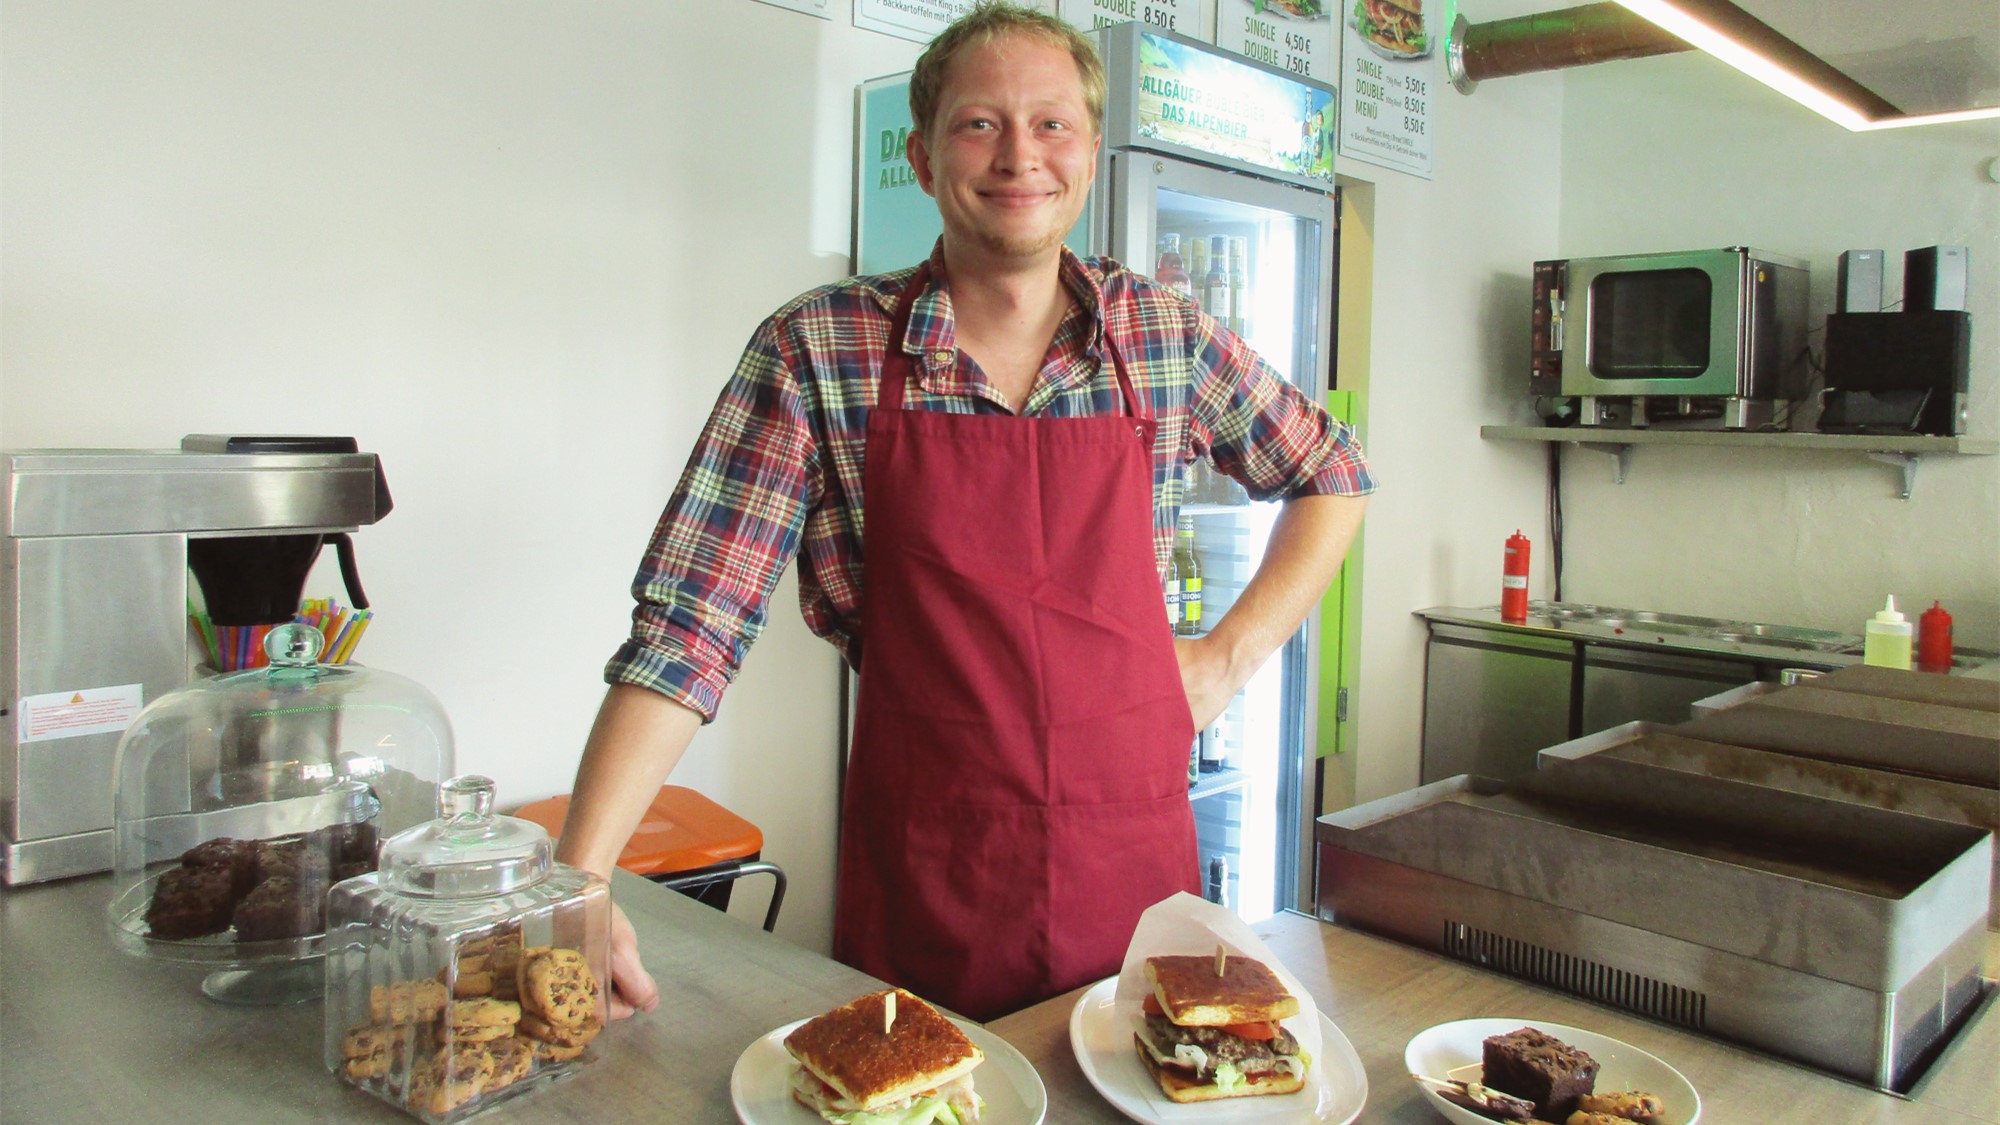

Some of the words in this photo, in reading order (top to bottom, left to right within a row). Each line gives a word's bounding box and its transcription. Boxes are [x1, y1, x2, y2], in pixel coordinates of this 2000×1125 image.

[934, 13, 945, 22] mit
[946, 13, 955, 23] Di
[1245, 16, 1275, 42] SINGLE
[1285, 32, 1304, 51] 4,50
[1305, 39, 1311, 54] €
[1244, 40, 1278, 65] DOUBLE
[1304, 61, 1310, 76] €
[1141, 75, 1202, 105] ALLGÄUER
[1356, 57, 1382, 80] SINGLE
[1405, 76, 1420, 94] 5,50
[1421, 82, 1426, 96] €
[1356, 79, 1384, 102] DOUBLE
[1405, 96, 1419, 113] 8,50
[1420, 102, 1425, 116] €
[1162, 102, 1184, 123] DAS
[1188, 110, 1248, 138] ALPENBIER
[1355, 99, 1378, 120] MENÜ
[1404, 116, 1419, 133] 8,50
[1420, 122, 1425, 136] €
[881, 127, 907, 162] DA
[880, 166, 917, 190] ALLG
